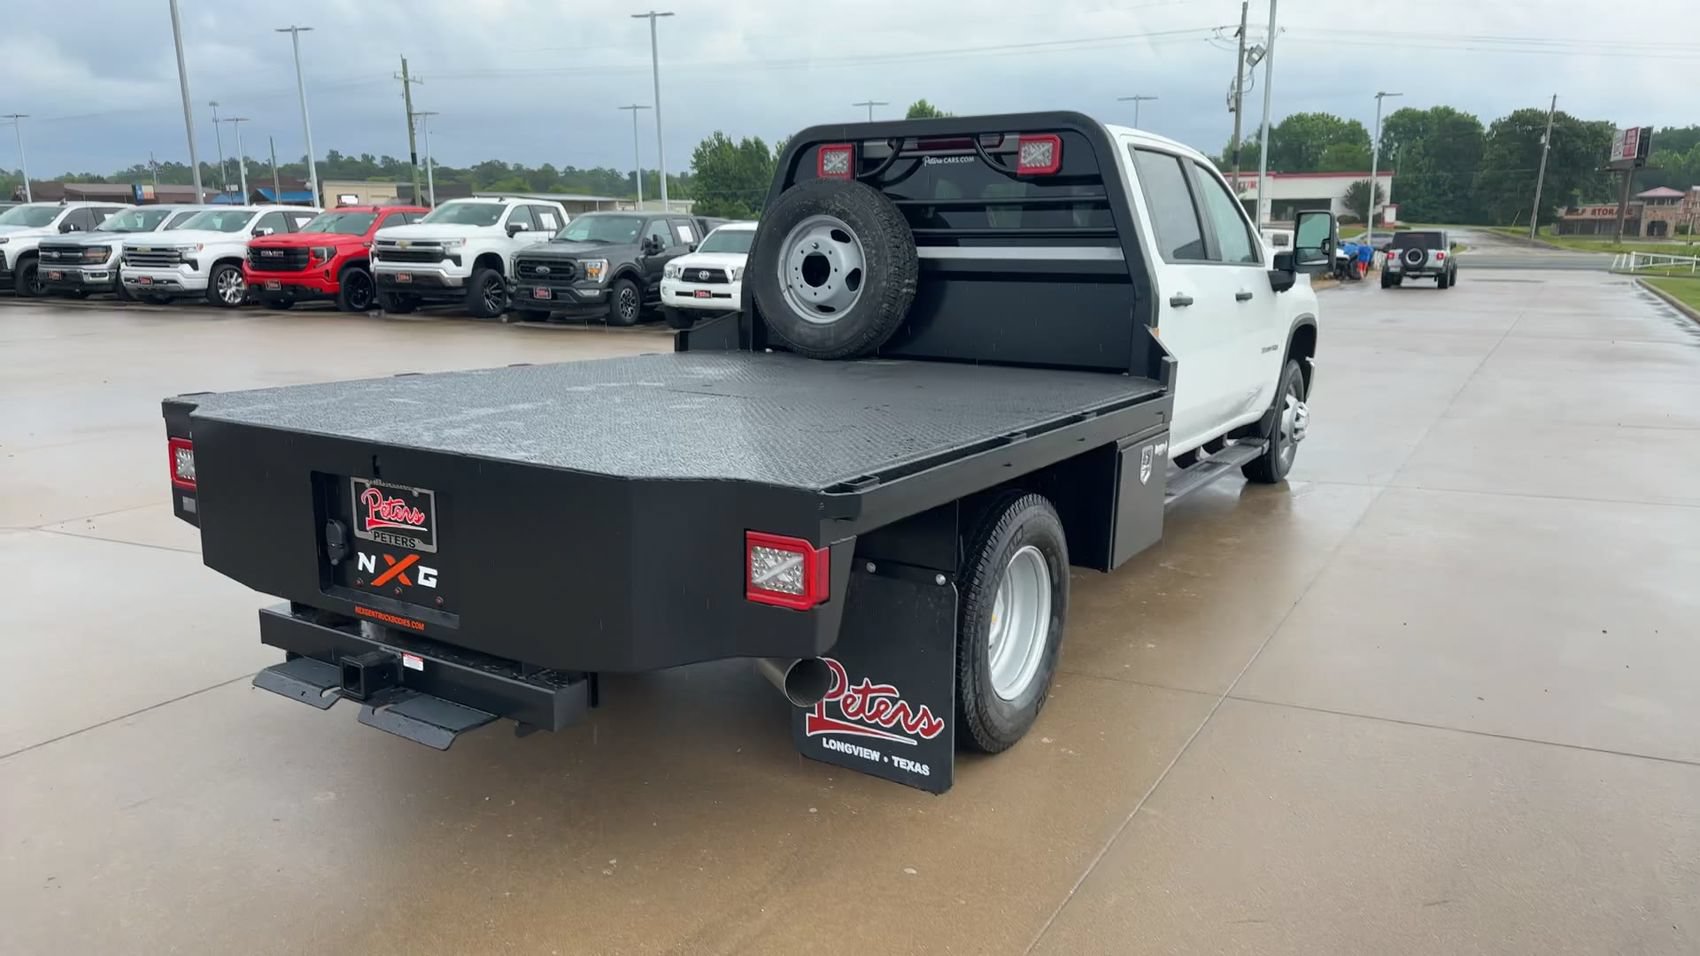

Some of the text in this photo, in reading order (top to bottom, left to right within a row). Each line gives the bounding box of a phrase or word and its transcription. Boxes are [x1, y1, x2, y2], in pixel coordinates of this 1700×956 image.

[361, 487, 427, 531] Peters
[373, 531, 417, 549] PETERS
[822, 737, 930, 776] LONGVIEW TEXAS
